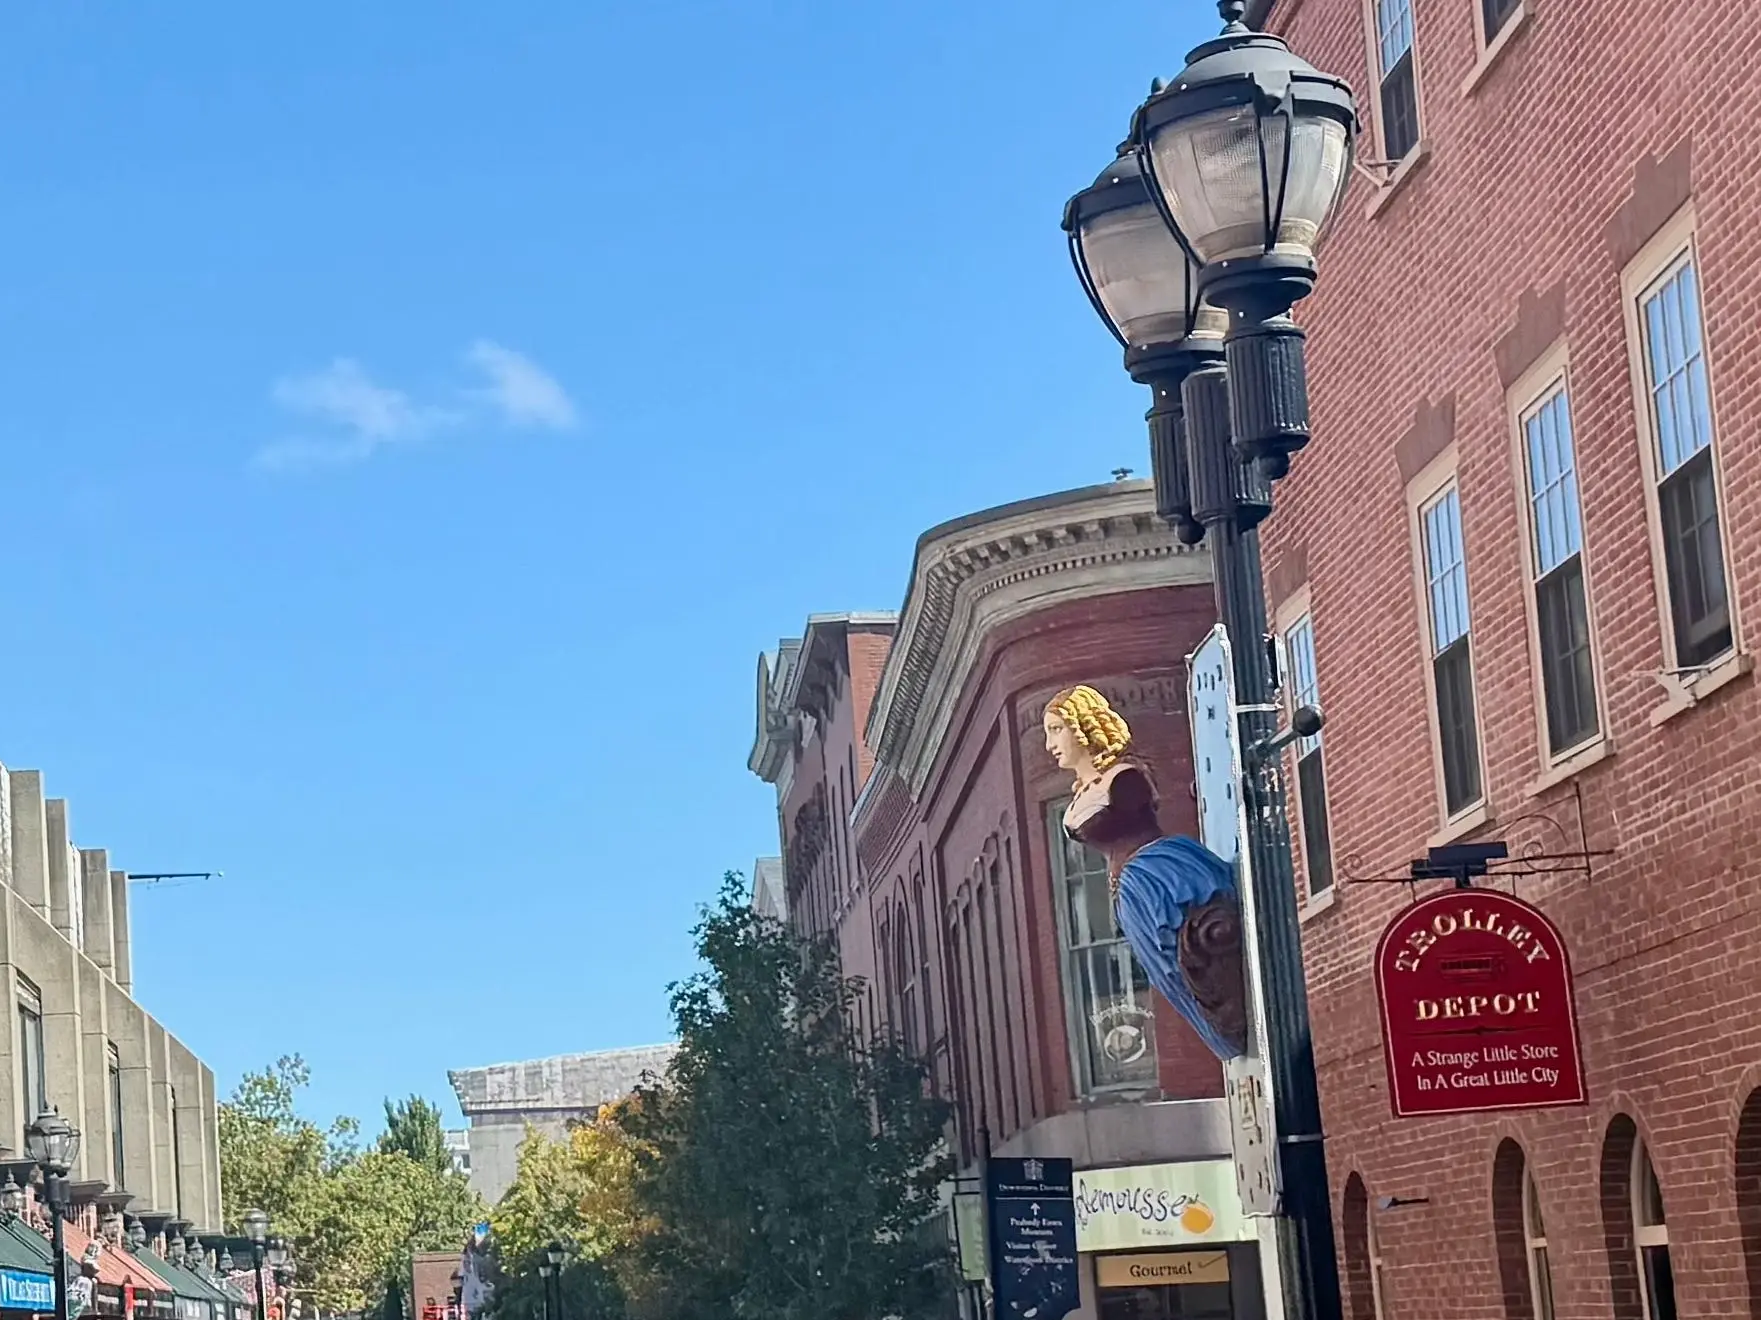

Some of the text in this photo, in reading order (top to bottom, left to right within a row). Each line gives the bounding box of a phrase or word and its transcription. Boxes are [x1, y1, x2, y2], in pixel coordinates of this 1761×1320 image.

[1395, 908, 1550, 972] TROLLEY
[1413, 991, 1540, 1021] DEPOT
[1411, 1043, 1560, 1069] A Strange Little Store
[1417, 1066, 1560, 1091] In A Great Little City
